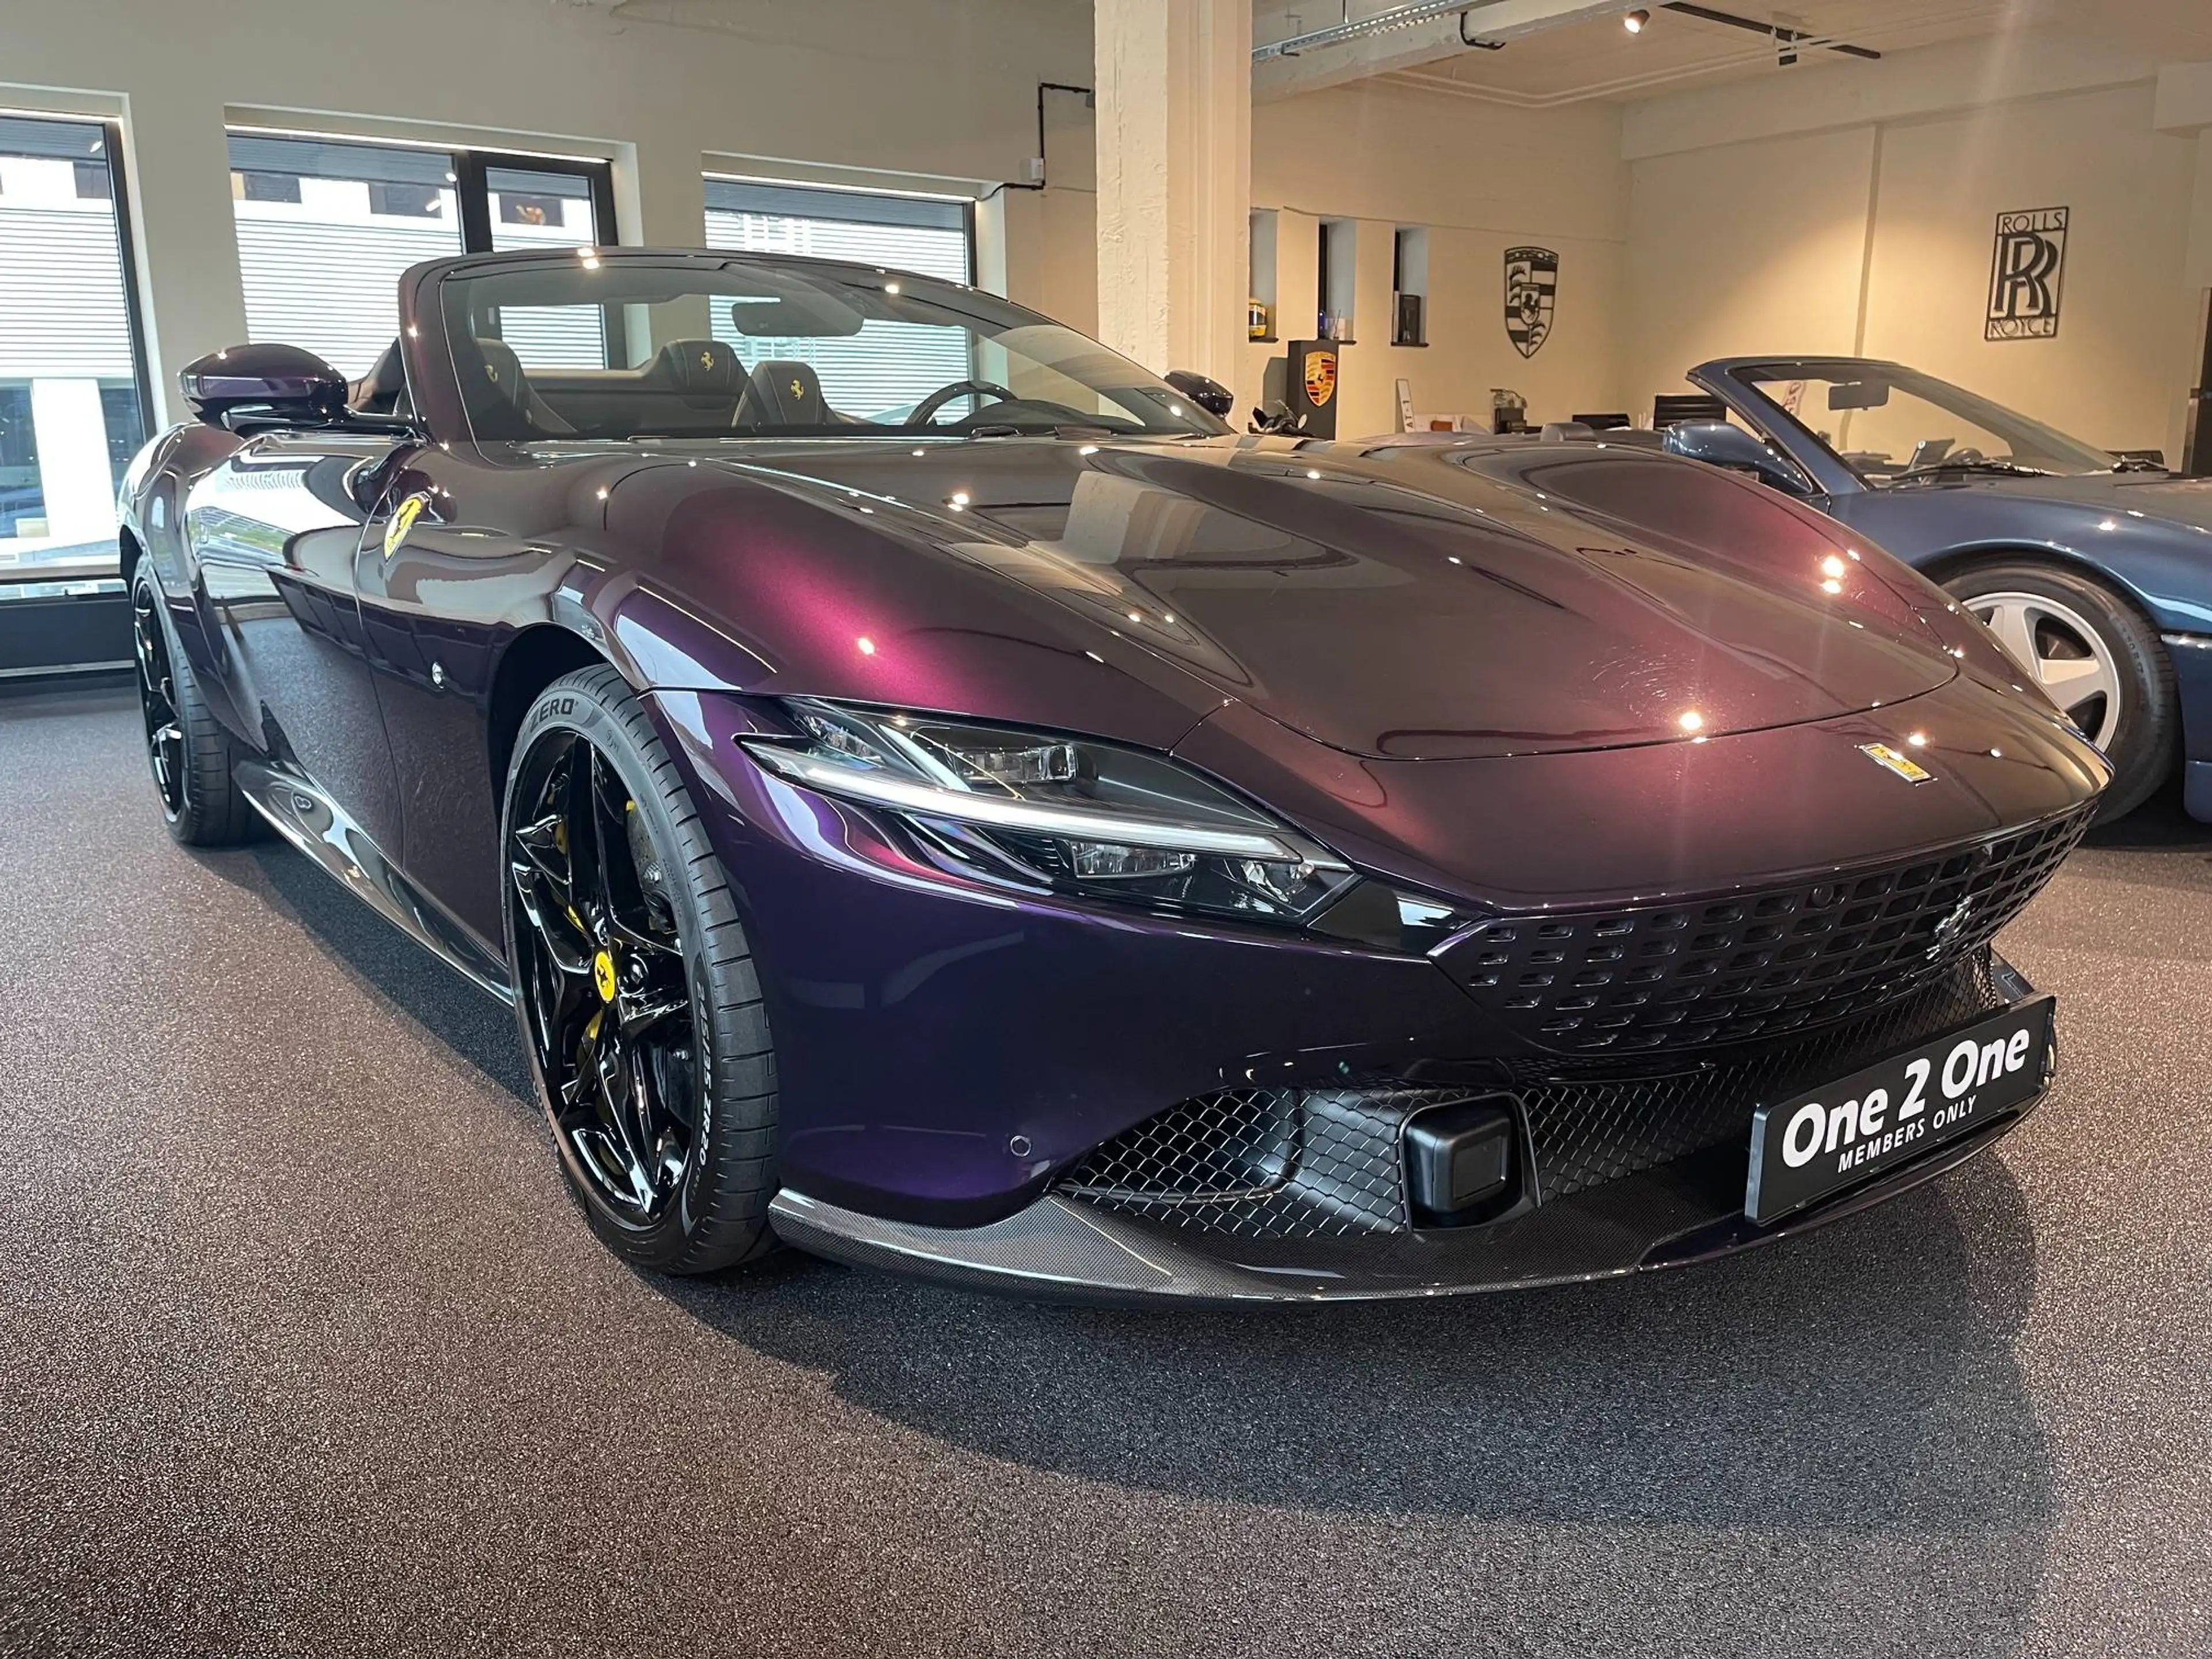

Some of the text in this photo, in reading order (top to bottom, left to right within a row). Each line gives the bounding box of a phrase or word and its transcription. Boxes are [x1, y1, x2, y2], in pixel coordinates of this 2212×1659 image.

[2002, 212, 2063, 234] ROLLS
[1990, 317, 2052, 338] ROYCE
[696, 981, 711, 1166] 245/35 ZR20
[1782, 1028, 2030, 1168] One 2 One
[1838, 1094, 1977, 1173] MEMBERS ONLY
